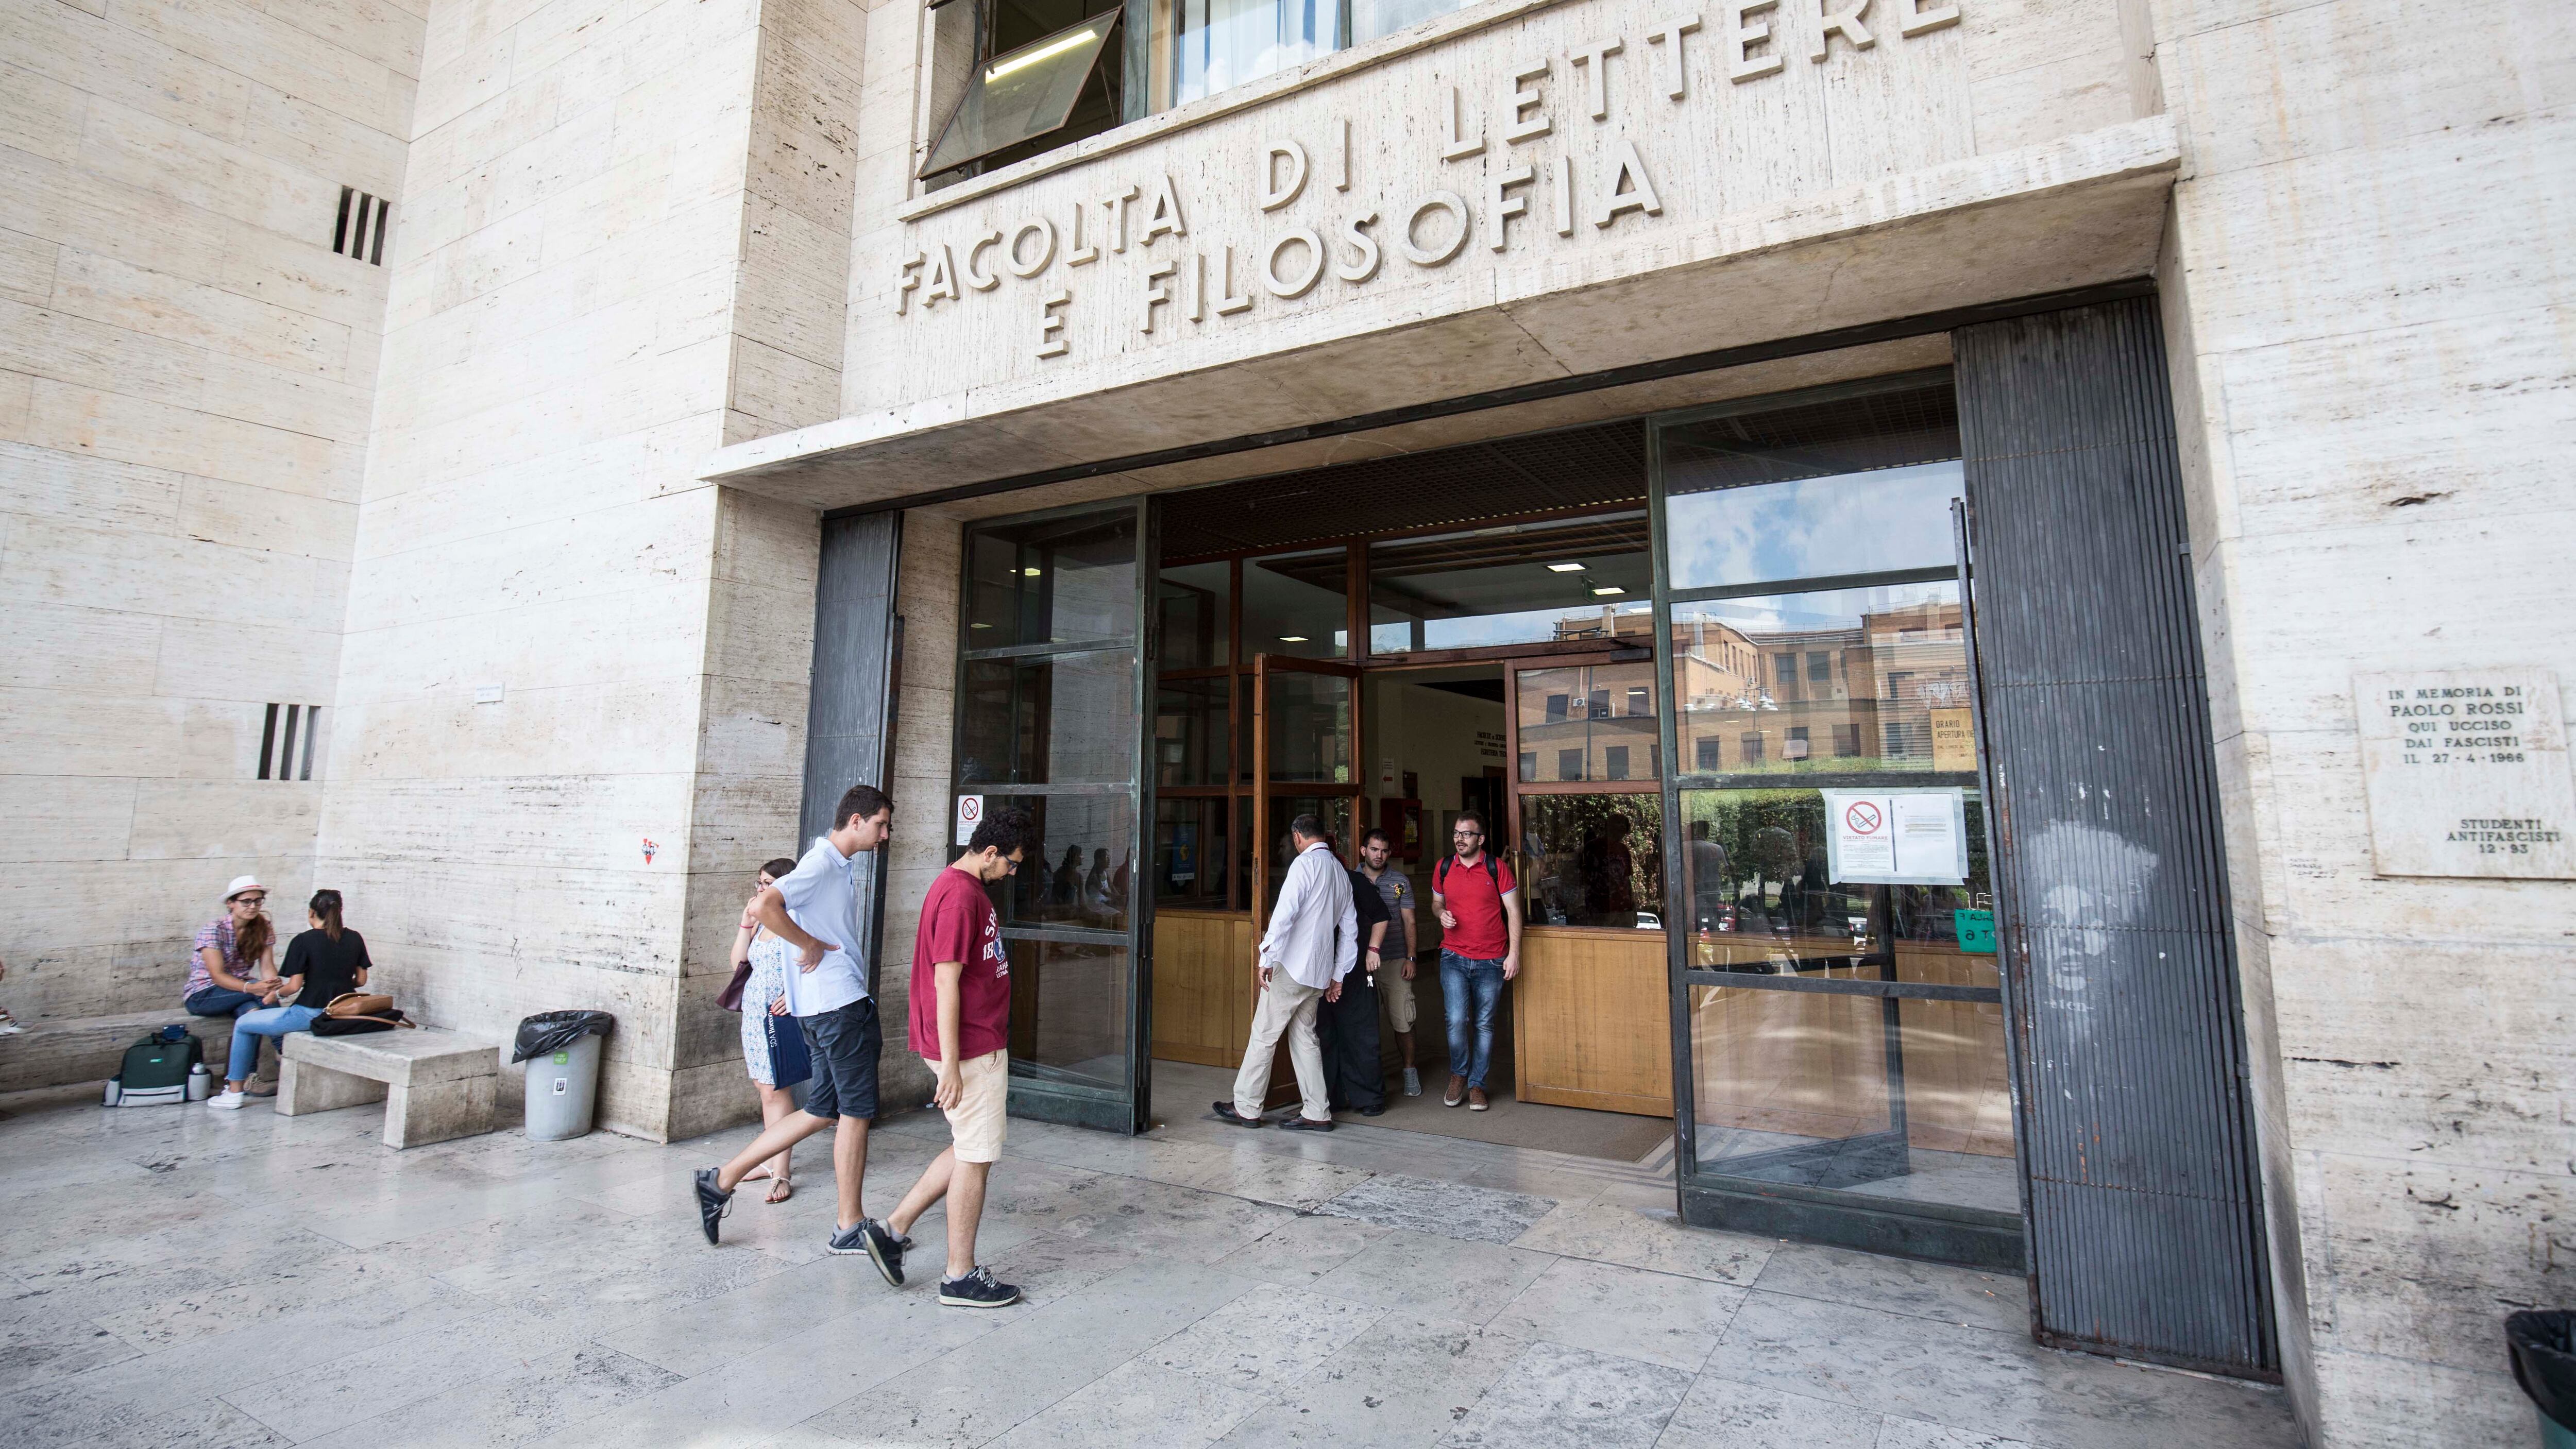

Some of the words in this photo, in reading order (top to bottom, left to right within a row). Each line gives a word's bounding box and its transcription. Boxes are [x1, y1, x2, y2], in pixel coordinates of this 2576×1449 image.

[896, 174, 1187, 316] FACOLTA
[1260, 118, 1350, 212] DI
[1036, 288, 1072, 360] E
[1140, 139, 1664, 334] FILOSOFIA
[2388, 690, 2404, 700] IN
[2416, 688, 2494, 698] MEMORIA
[2504, 686, 2522, 696] DI
[2391, 704, 2454, 717] PAOLO
[2466, 702, 2524, 715] ROSSI
[2409, 722, 2437, 733] QUI
[2449, 721, 2512, 731] UCCISO
[2405, 738, 2432, 747] DAI
[2444, 736, 2519, 747] FASCISTI
[2403, 754, 2420, 763] IL
[2461, 819, 2541, 829] STUDENTI
[2447, 831, 2561, 841] ANTIFASCISTI
